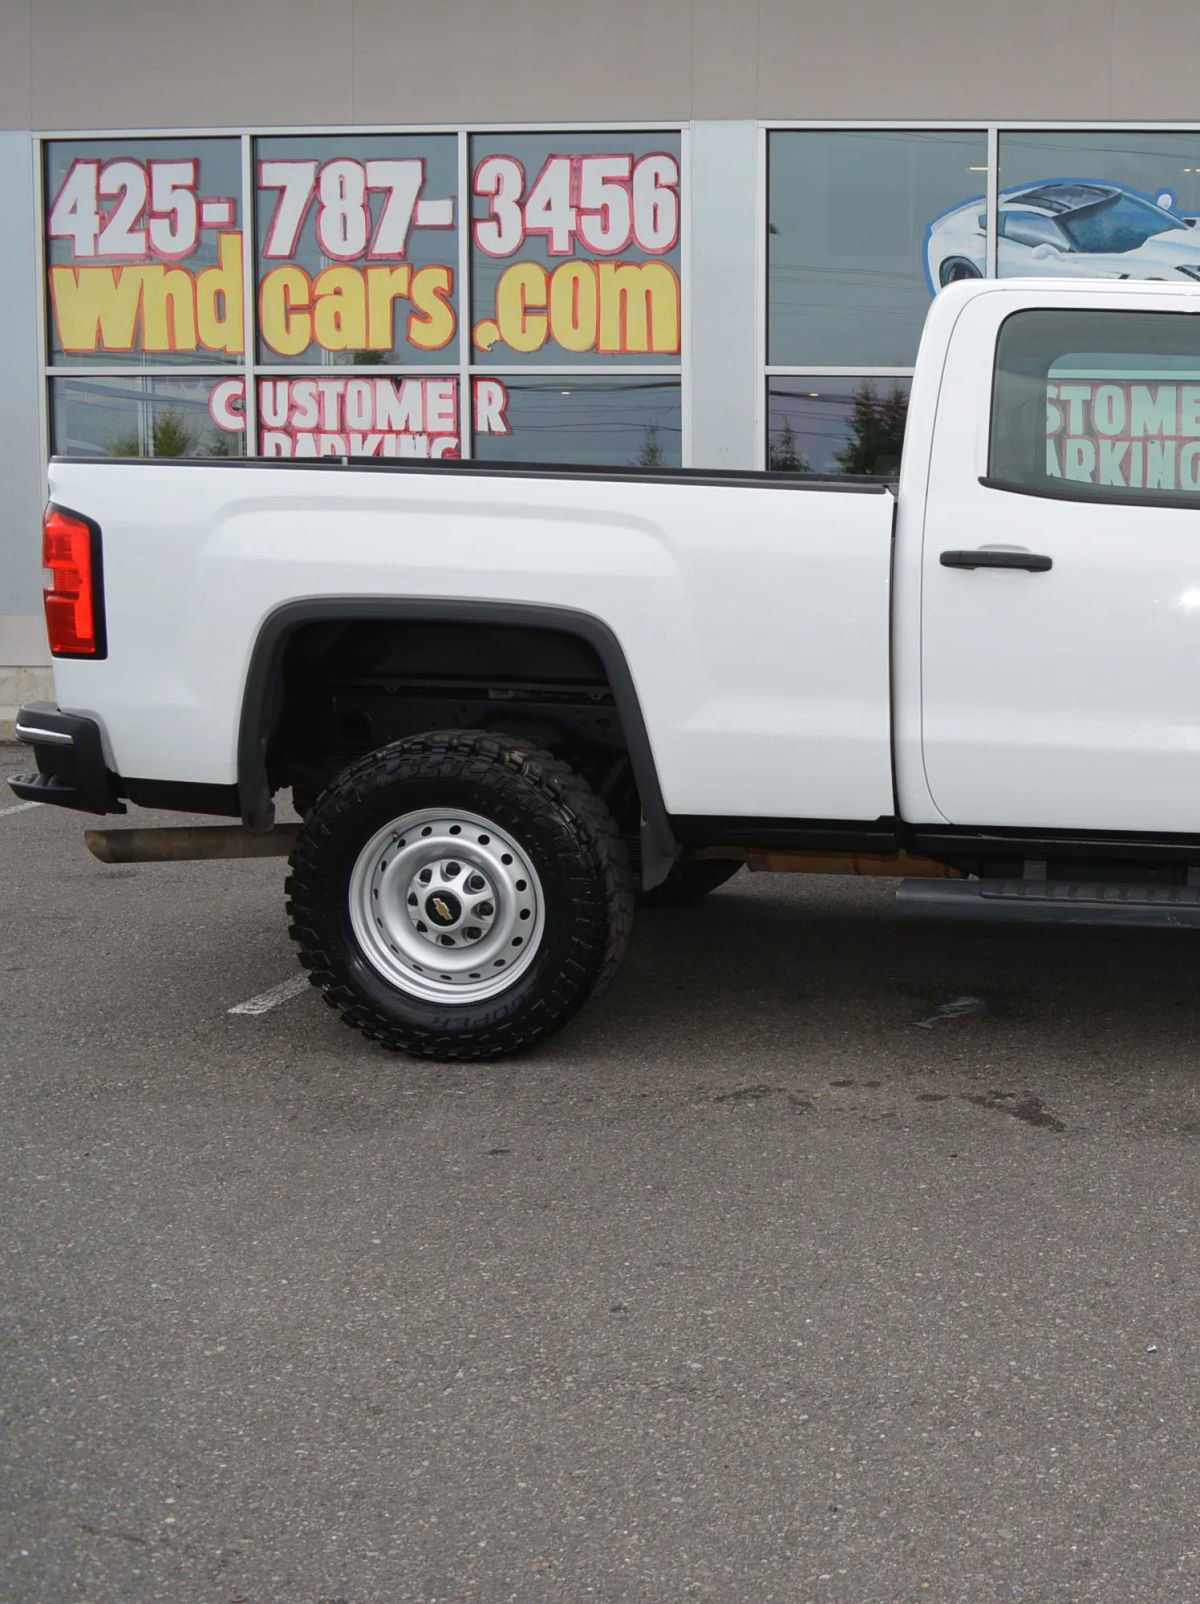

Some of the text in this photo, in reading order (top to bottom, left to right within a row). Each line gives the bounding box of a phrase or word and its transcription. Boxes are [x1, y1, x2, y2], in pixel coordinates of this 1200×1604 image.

[48, 151, 679, 262] 425- 787- 3456
[258, 263, 457, 358] cars
[472, 258, 681, 354] .com
